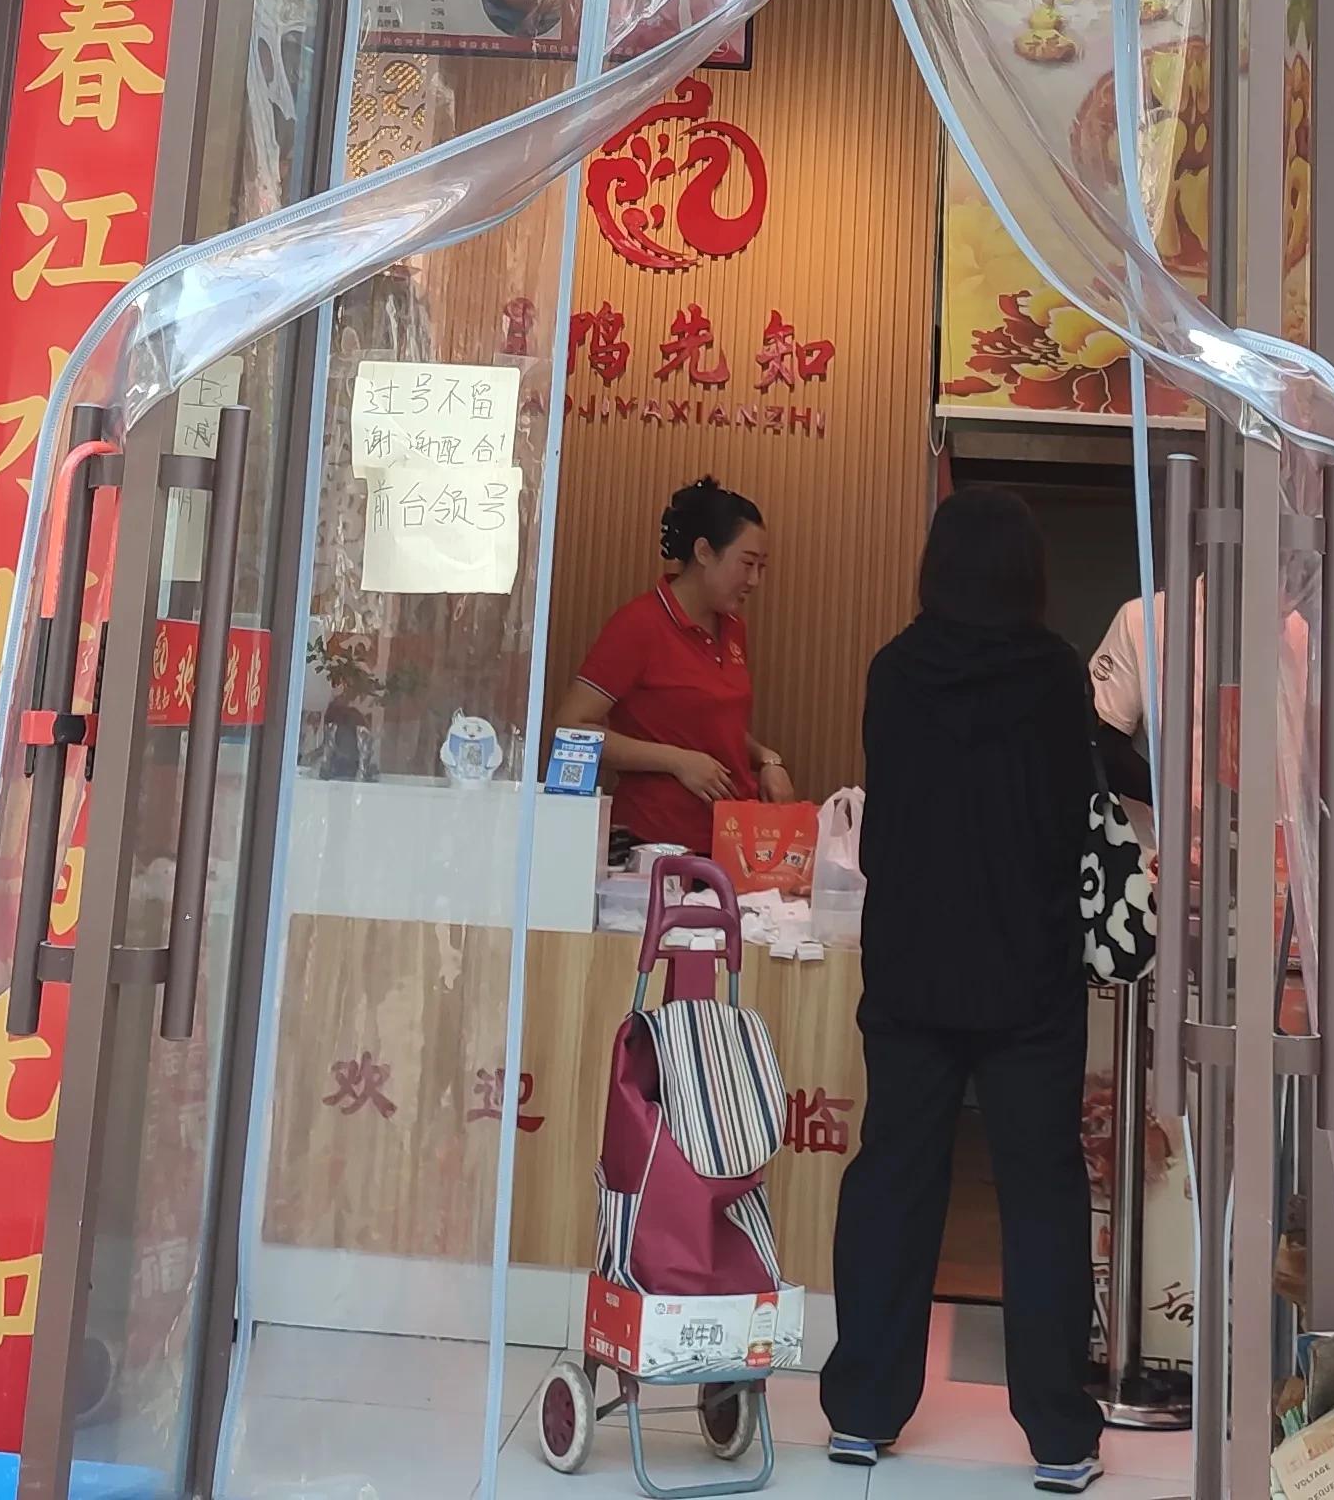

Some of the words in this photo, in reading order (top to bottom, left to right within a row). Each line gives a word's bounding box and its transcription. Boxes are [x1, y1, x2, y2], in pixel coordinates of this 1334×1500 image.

[363, 373, 494, 420] 过号不留
[372, 481, 510, 534] 前台领号
[173, 643, 263, 717] 欢光临
[679, 1323, 724, 1347] 纯牛奶
[1294, 1462, 1332, 1491] VOLTAGE
